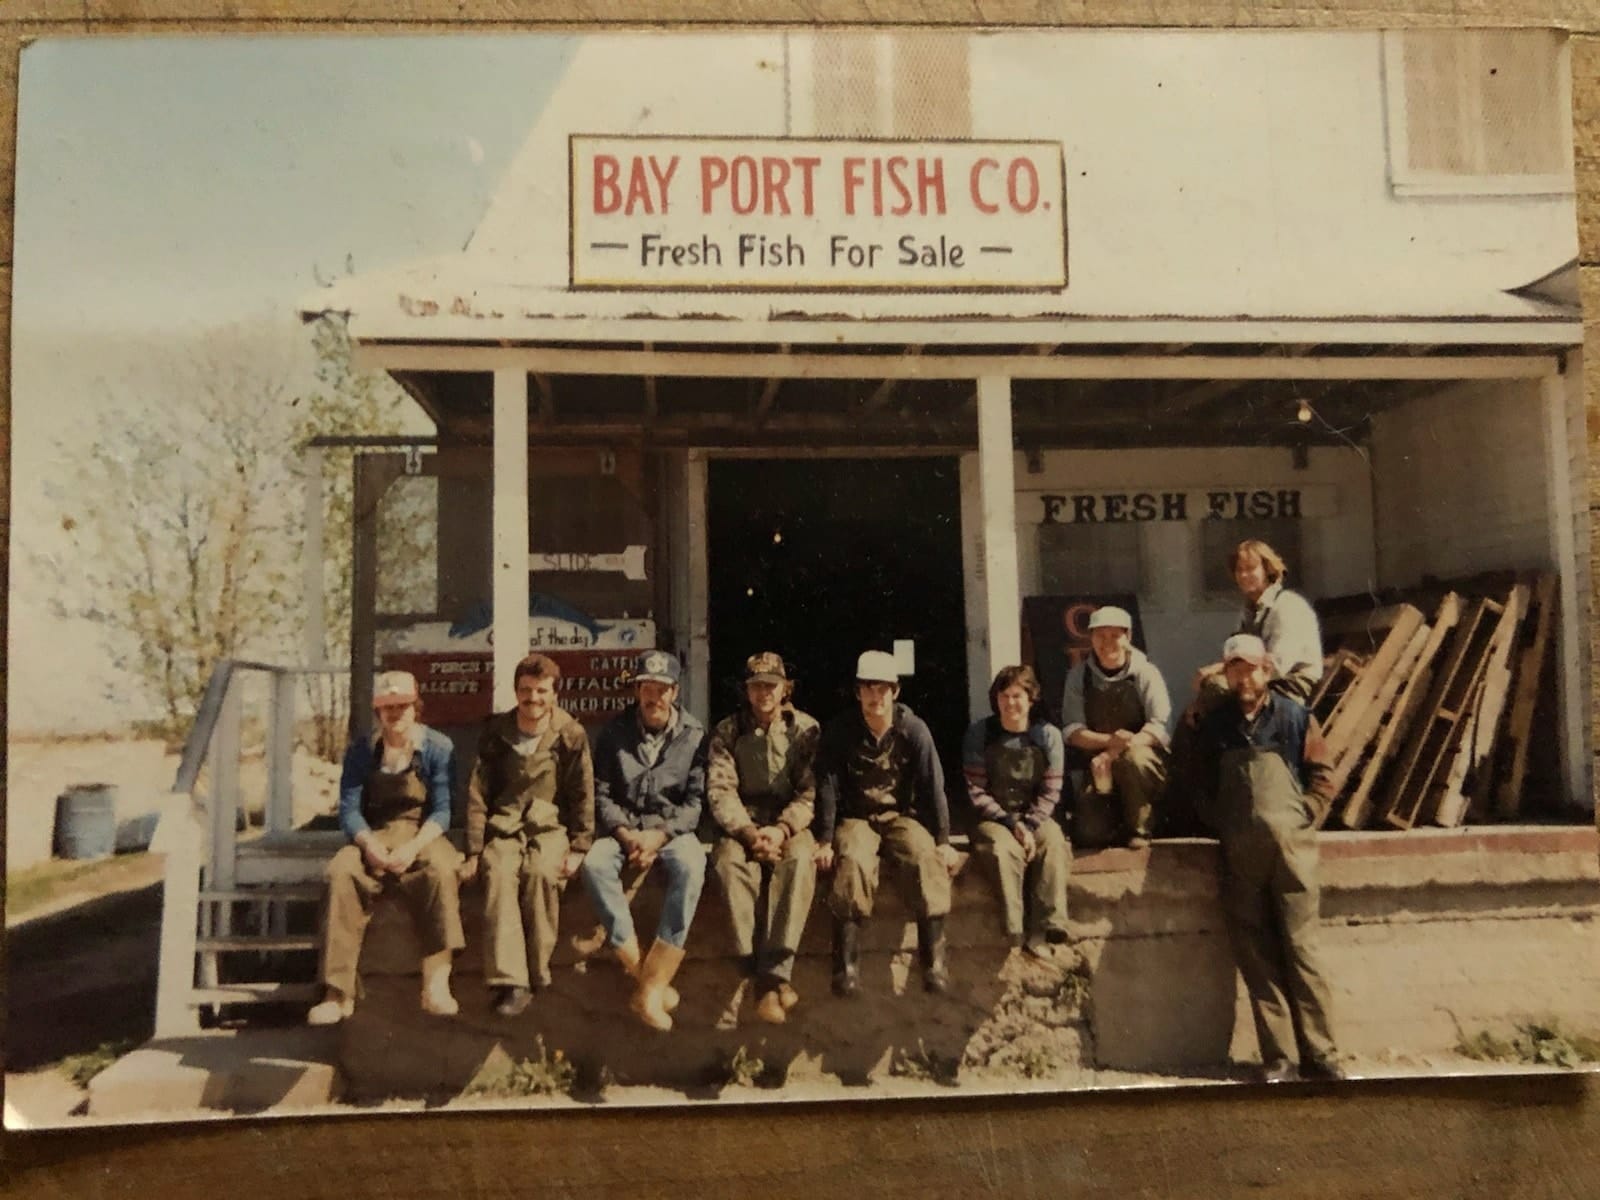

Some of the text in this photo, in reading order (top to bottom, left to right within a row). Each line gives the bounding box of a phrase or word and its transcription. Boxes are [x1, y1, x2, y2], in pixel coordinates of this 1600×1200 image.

[592, 154, 1052, 217] BAY PORT FISH CO.
[641, 233, 966, 268] Fresh Fish For Sale
[1040, 489, 1303, 525] FRESH FISH
[529, 627, 545, 646] of
[548, 626, 568, 645] the
